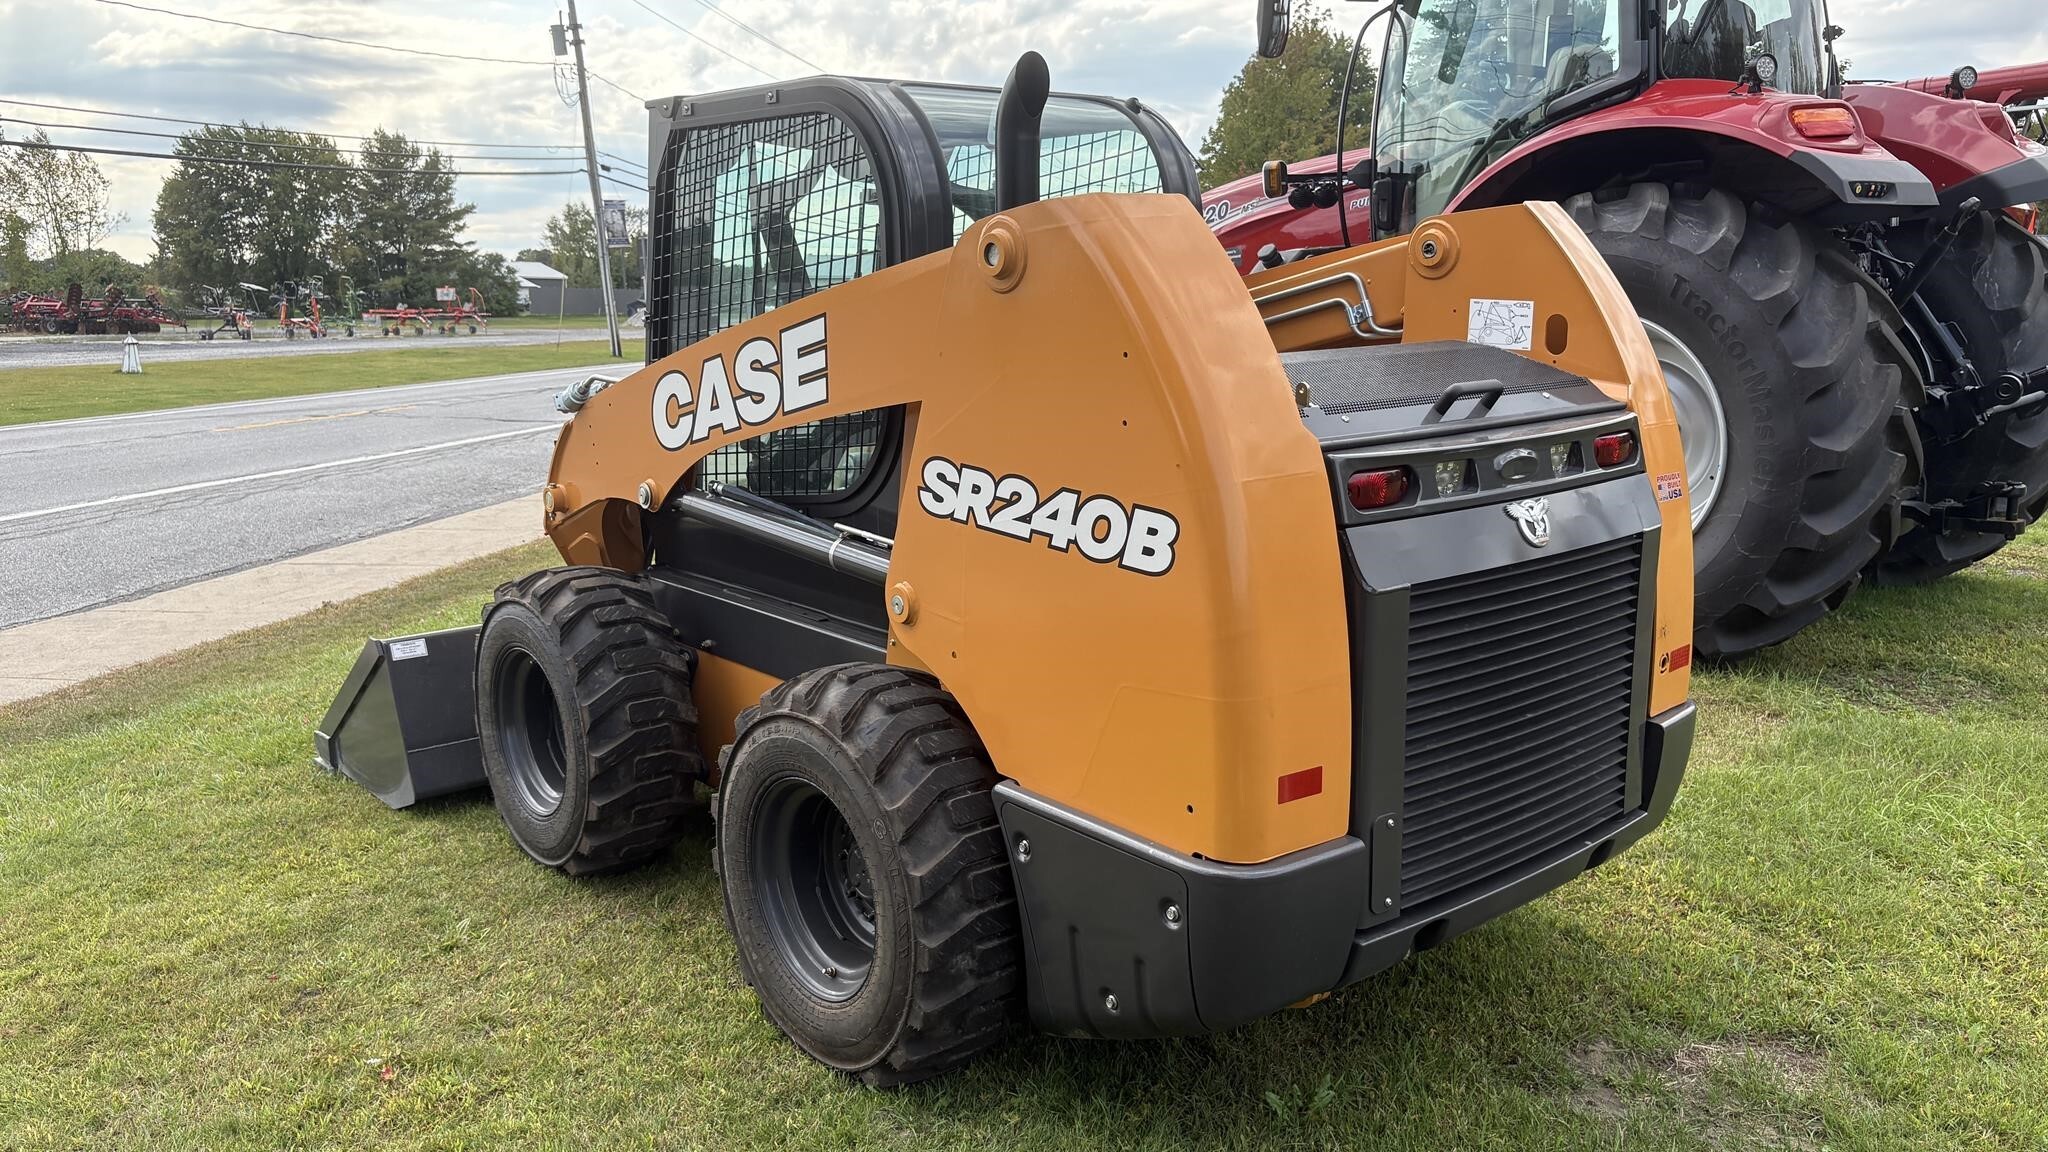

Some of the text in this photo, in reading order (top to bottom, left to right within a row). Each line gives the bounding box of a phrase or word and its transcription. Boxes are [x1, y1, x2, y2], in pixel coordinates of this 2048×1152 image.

[652, 312, 828, 452] CASE
[1656, 473, 1681, 482] PROUDLY
[1667, 481, 1681, 489] BUILT
[1668, 489, 1682, 499] USA
[918, 456, 1180, 577] SR240B
